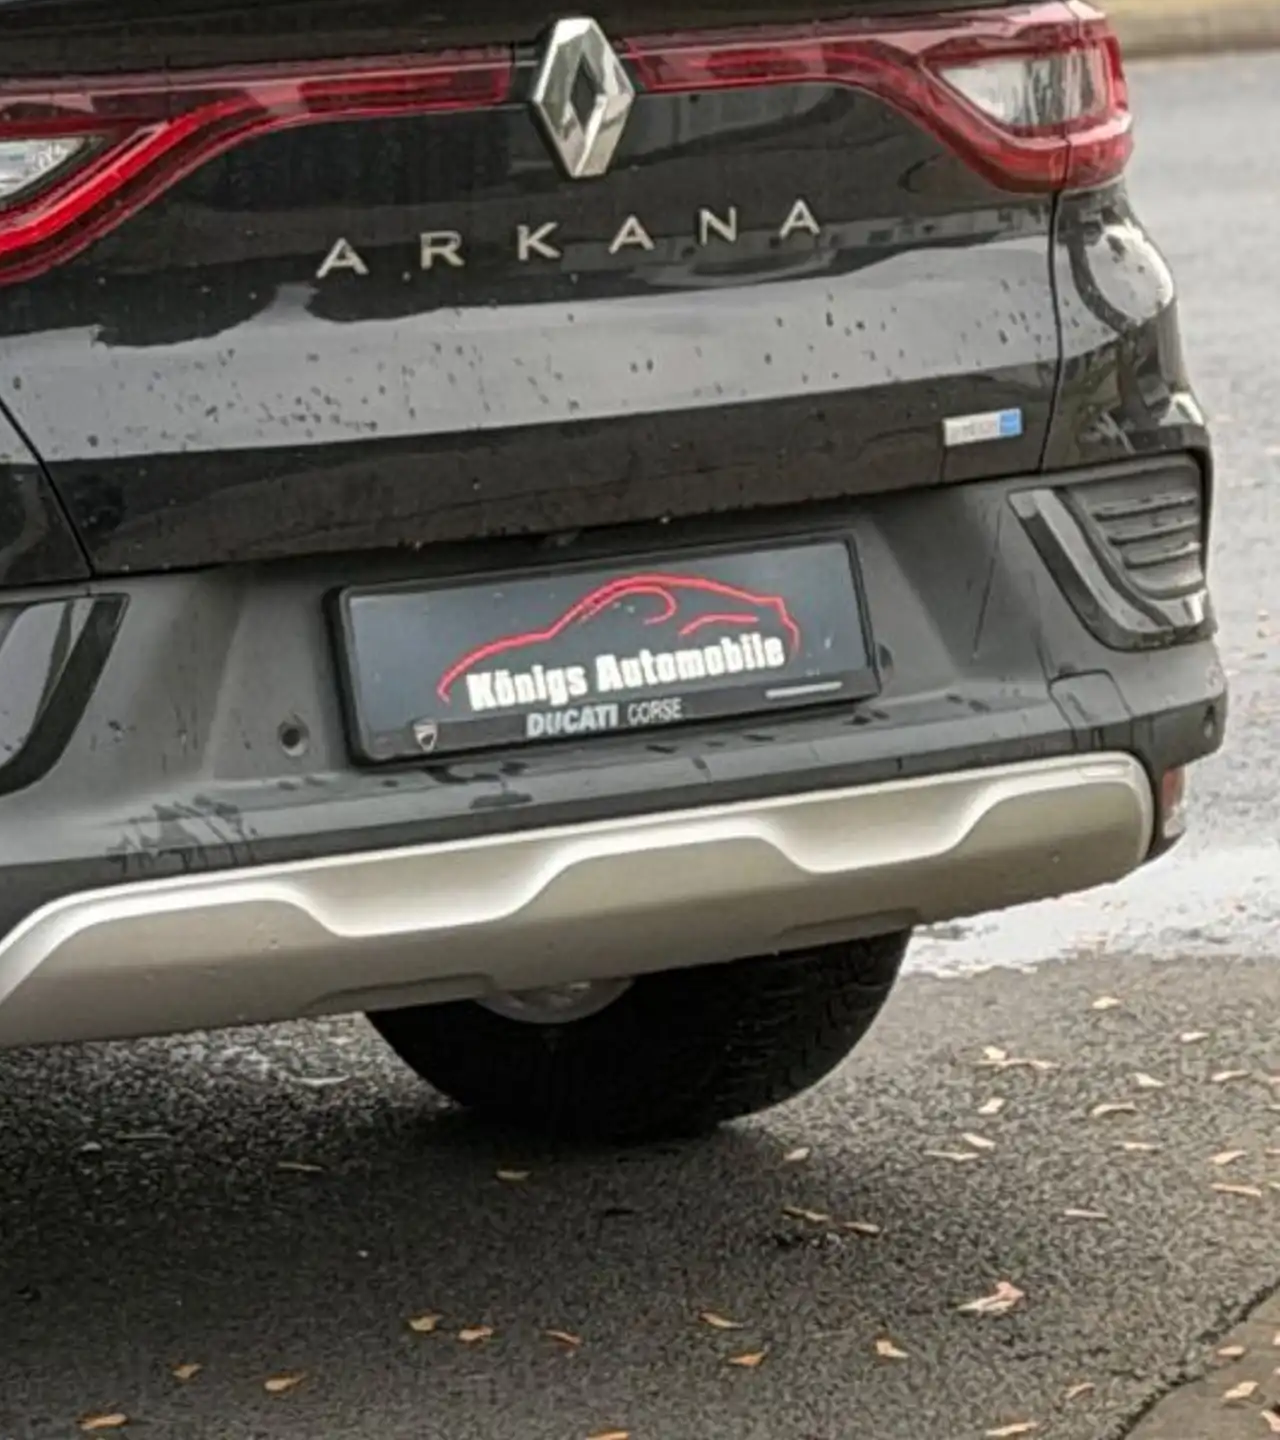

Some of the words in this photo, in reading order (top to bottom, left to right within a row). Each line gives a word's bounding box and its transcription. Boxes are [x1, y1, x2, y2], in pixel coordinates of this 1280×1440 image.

[316, 199, 821, 278] ARKANA
[466, 663, 587, 711] Königs
[595, 632, 785, 693] Automobile
[526, 703, 619, 738] DUCATI
[627, 698, 683, 725] CORSE
